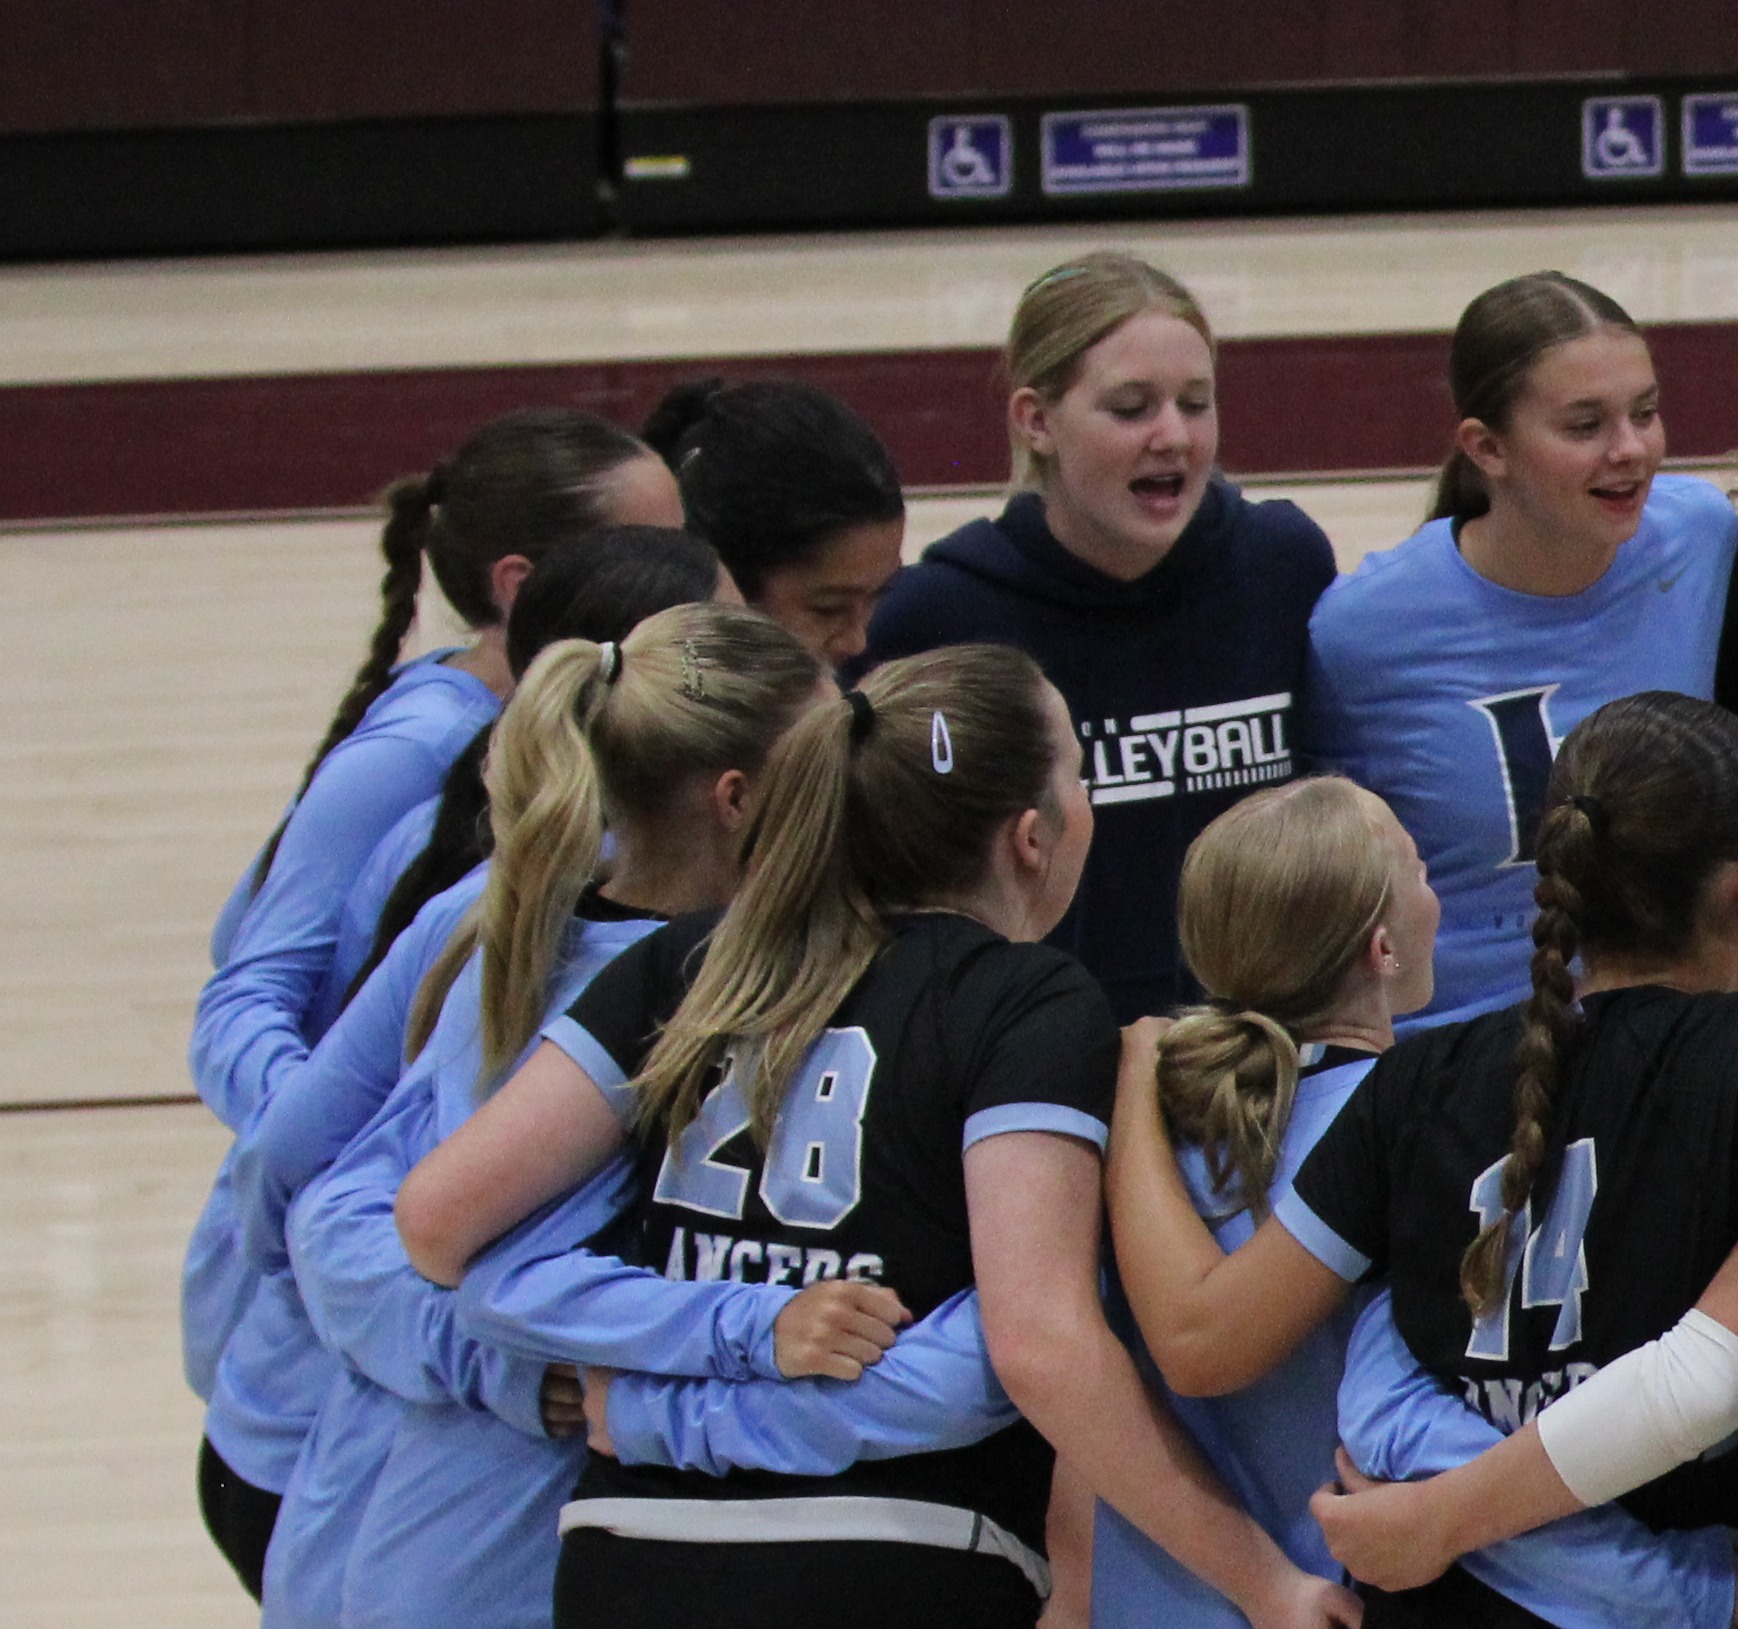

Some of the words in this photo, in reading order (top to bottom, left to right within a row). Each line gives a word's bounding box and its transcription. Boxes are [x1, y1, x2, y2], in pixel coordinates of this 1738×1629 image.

[652, 1025, 878, 1230] 28
[643, 1218, 884, 1288] ANCERS
[1464, 1137, 1598, 1362] 14
